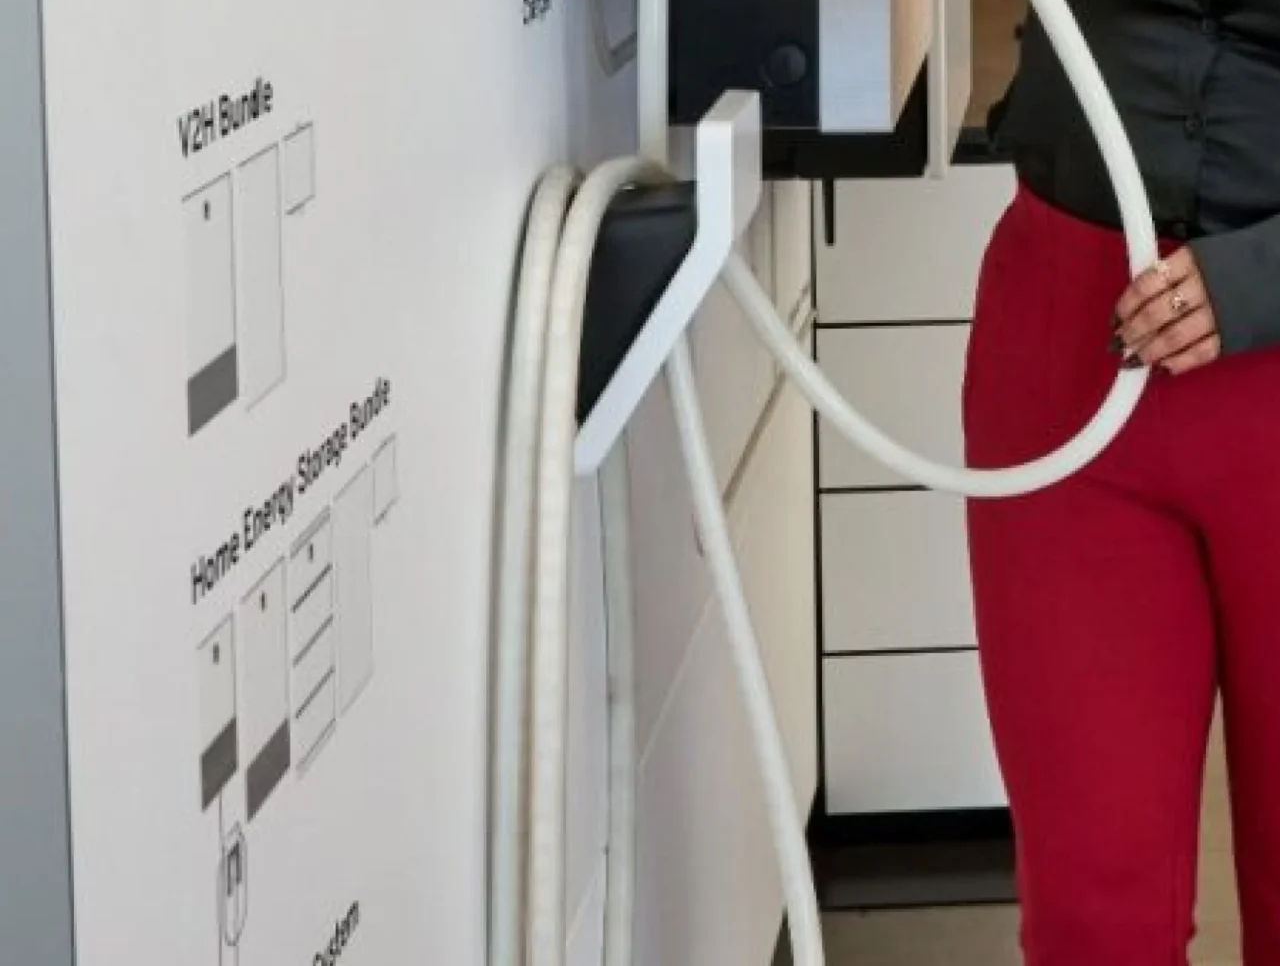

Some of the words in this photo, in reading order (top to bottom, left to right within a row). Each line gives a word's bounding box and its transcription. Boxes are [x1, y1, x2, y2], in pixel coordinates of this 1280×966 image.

[178, 99, 216, 158] V2H
[219, 76, 273, 137] Bundle
[191, 532, 239, 605] Home
[244, 475, 294, 551] Energy
[298, 423, 347, 494] Storage
[350, 377, 390, 440] Bundle
